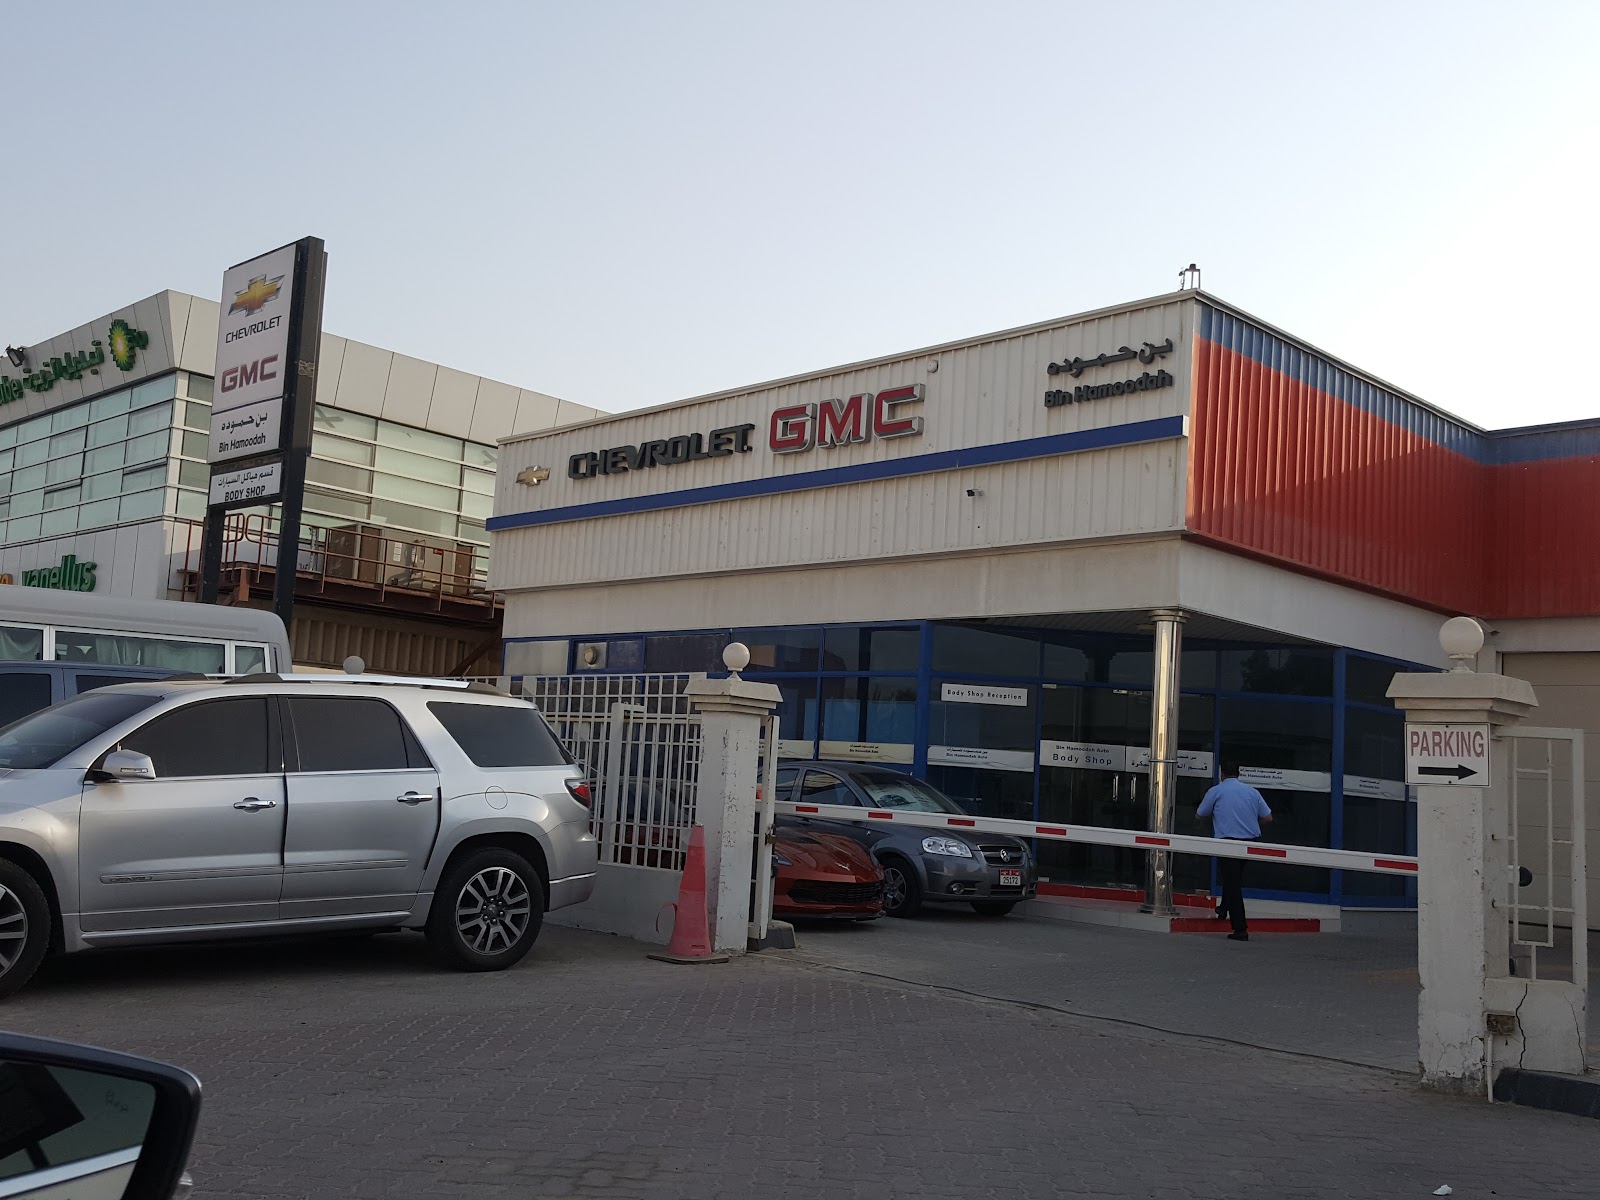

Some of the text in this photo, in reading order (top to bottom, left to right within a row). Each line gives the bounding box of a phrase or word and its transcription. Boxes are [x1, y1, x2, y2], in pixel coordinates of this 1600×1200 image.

[226, 315, 282, 344] CHEVROLET
[1138, 337, 1173, 365] بن
[220, 353, 279, 394] GMC
[1044, 369, 1173, 408] Bin Hamoodah
[255, 412, 268, 428] بن
[769, 383, 926, 455] GMC
[218, 432, 266, 453] Bin Hamoodah
[568, 423, 756, 480] CHEVROLET
[258, 466, 274, 479] قسم
[224, 485, 266, 501] BODY SHOP
[21, 554, 98, 592] vanellus
[947, 689, 1022, 700] Body Shop Reception
[1410, 731, 1485, 757] PARKING
[1052, 753, 1113, 767] Body Shop
